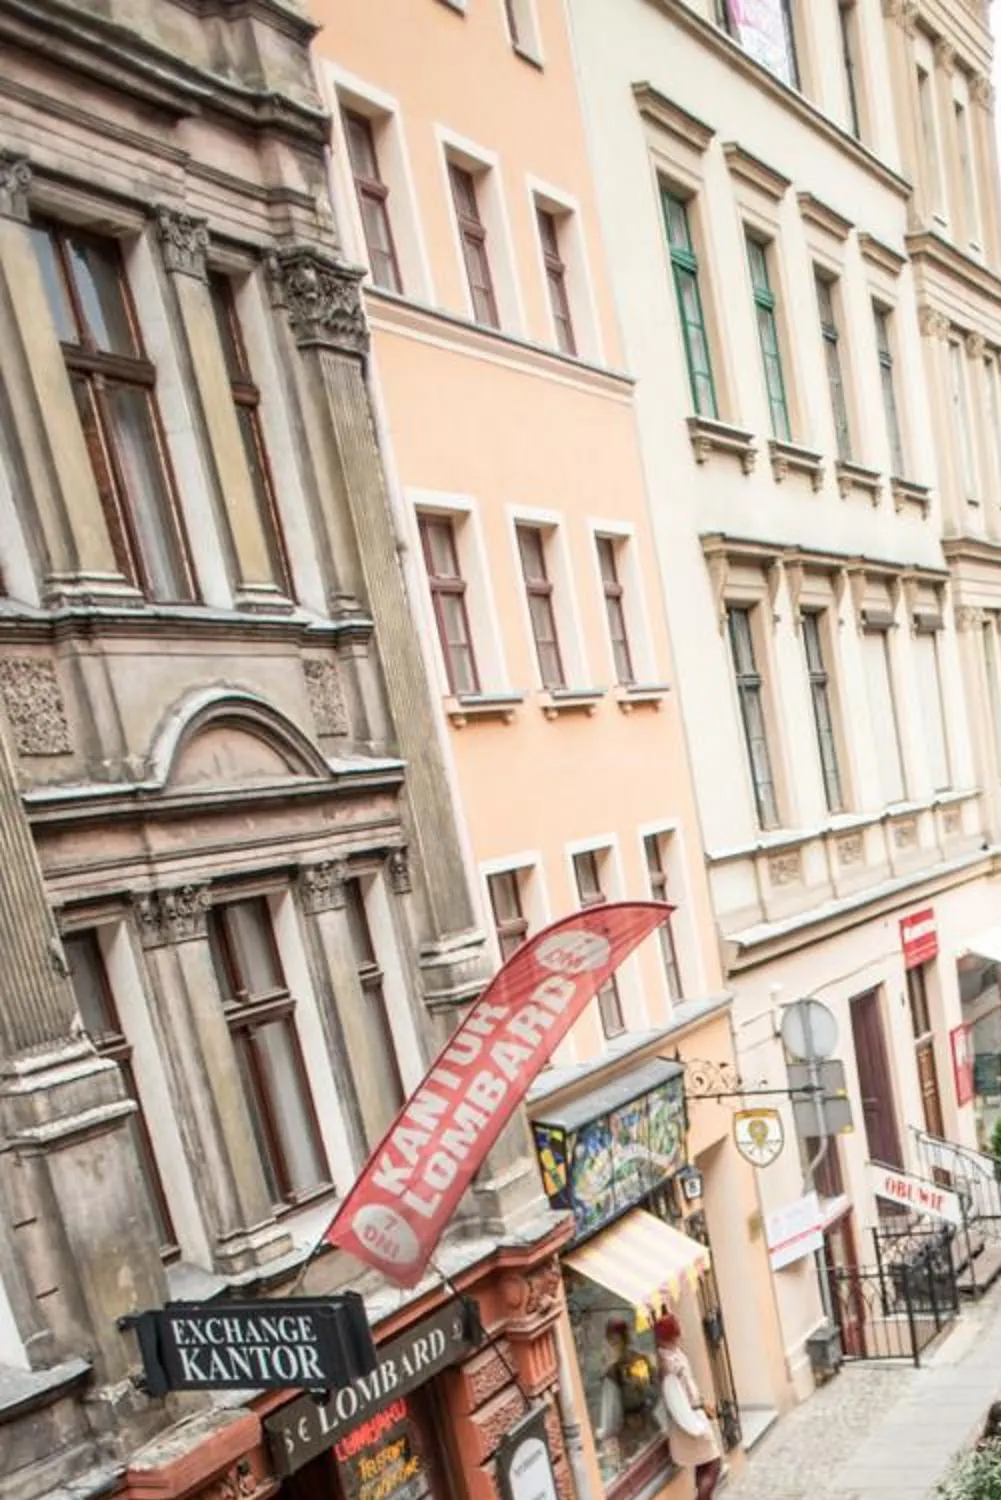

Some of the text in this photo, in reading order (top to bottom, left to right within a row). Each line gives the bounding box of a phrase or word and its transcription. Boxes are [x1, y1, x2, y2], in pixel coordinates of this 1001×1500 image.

[403, 974, 577, 1218] LOMBARD
[171, 1315, 317, 1346] EXCHANGE
[178, 1345, 325, 1381] KANTOR
[316, 1328, 446, 1435] LOMBARD
